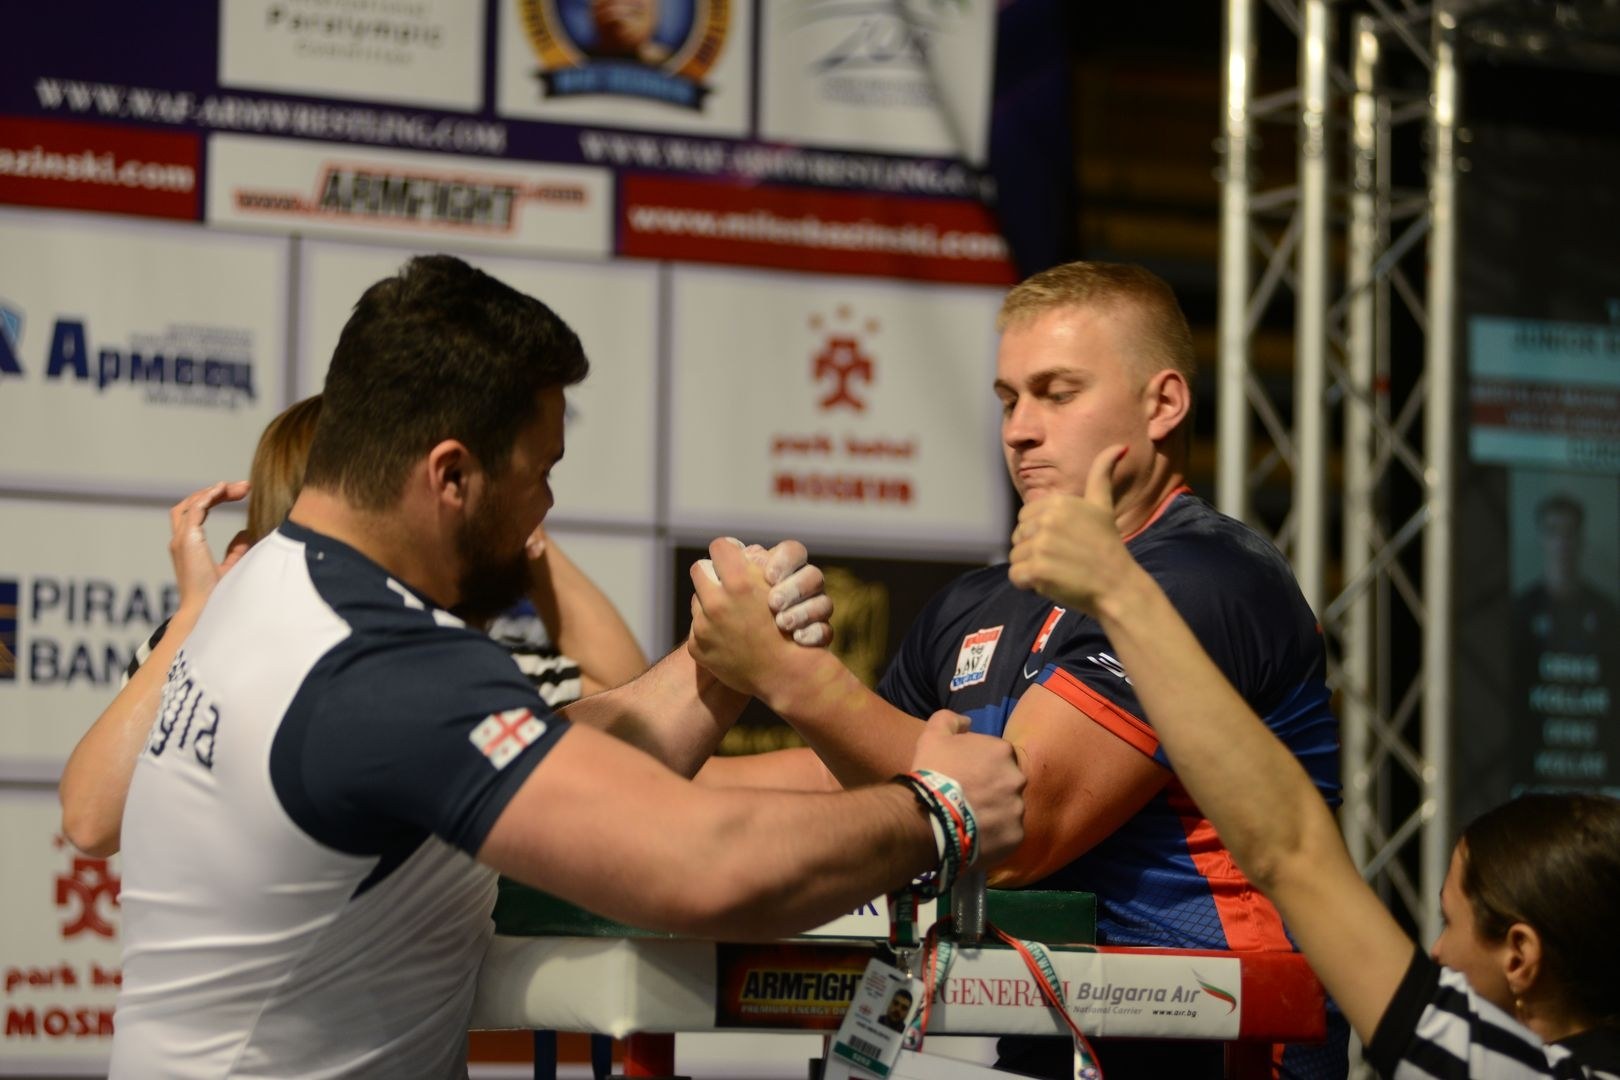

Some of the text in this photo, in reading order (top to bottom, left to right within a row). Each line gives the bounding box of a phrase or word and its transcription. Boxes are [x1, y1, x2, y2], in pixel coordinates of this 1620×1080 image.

[265, 4, 445, 49] Paralympic
[30, 580, 181, 625] PIRAE
[30, 638, 137, 684] BAN
[742, 971, 864, 1001] ARMFIGH
[1077, 983, 1200, 1005] Bulgaria Air
[4, 1007, 115, 1040] MOSK
[1073, 1006, 1143, 1015] National Carrier
[1153, 1009, 1197, 1019] www.air.bg
